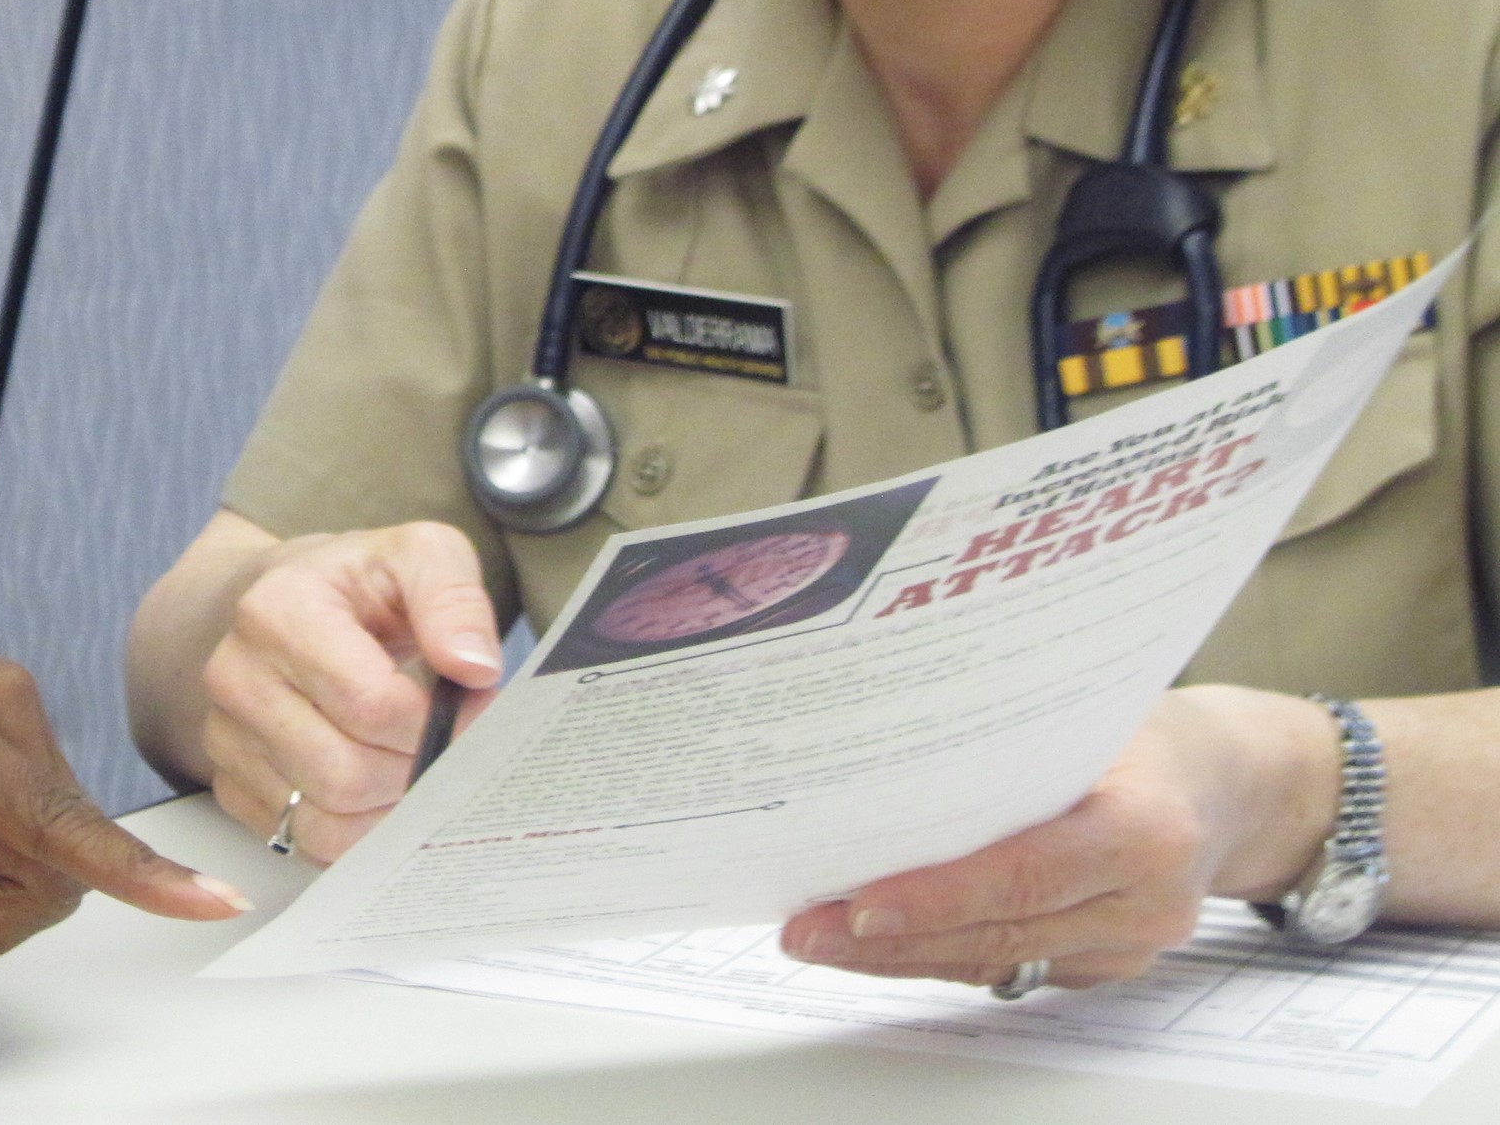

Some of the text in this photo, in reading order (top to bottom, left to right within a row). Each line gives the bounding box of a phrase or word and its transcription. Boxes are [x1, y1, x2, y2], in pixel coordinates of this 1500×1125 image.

[991, 391, 1288, 511] Increased Risk
[1017, 429, 1237, 518] of Having a
[1030, 380, 1281, 482] Are You at an
[873, 457, 1268, 619] ATTACK?
[953, 432, 1258, 566] HEART
[419, 826, 605, 851] Learn More
